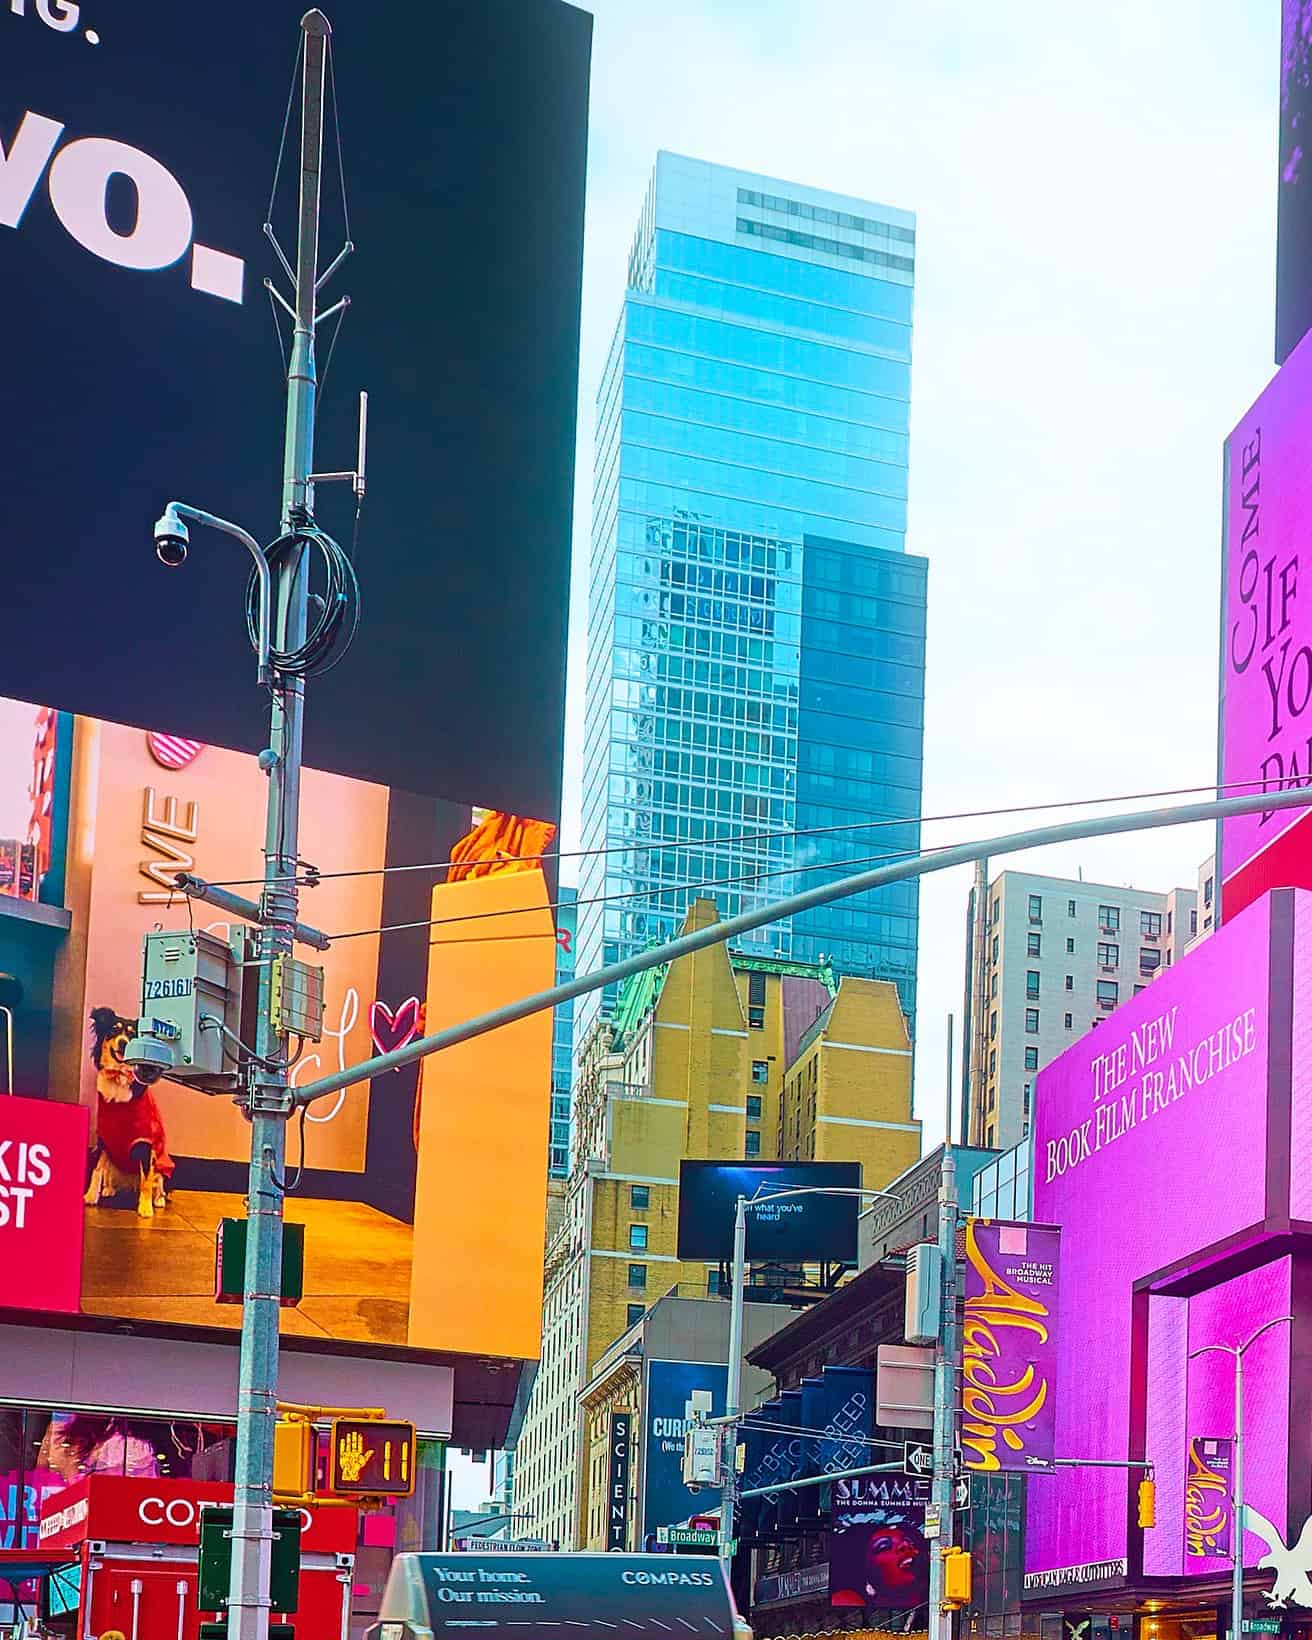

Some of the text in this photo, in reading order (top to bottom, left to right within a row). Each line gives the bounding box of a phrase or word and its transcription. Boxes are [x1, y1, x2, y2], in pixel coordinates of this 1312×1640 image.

[1231, 426, 1263, 675] COME
[1262, 553, 1299, 653] IF
[1090, 1005, 1179, 1103] THE NEW
[1045, 1006, 1257, 1185] BOOK FILM FRANCHISE
[17, 1143, 51, 1187] IS
[755, 1202, 775, 1213] what
[776, 1203, 804, 1217] you've
[756, 1212, 780, 1222] heard
[1006, 1268, 1053, 1279] BROADWAY
[1021, 1261, 1053, 1271] THE HIT
[1016, 1275, 1053, 1286] MUSICAL
[1025, 1455, 1049, 1467] Disney
[671, 1530, 716, 1545] Broadway
[433, 1567, 532, 1584] Your home.
[621, 1570, 713, 1587] COMPASS
[438, 1587, 546, 1604] Our mission.
